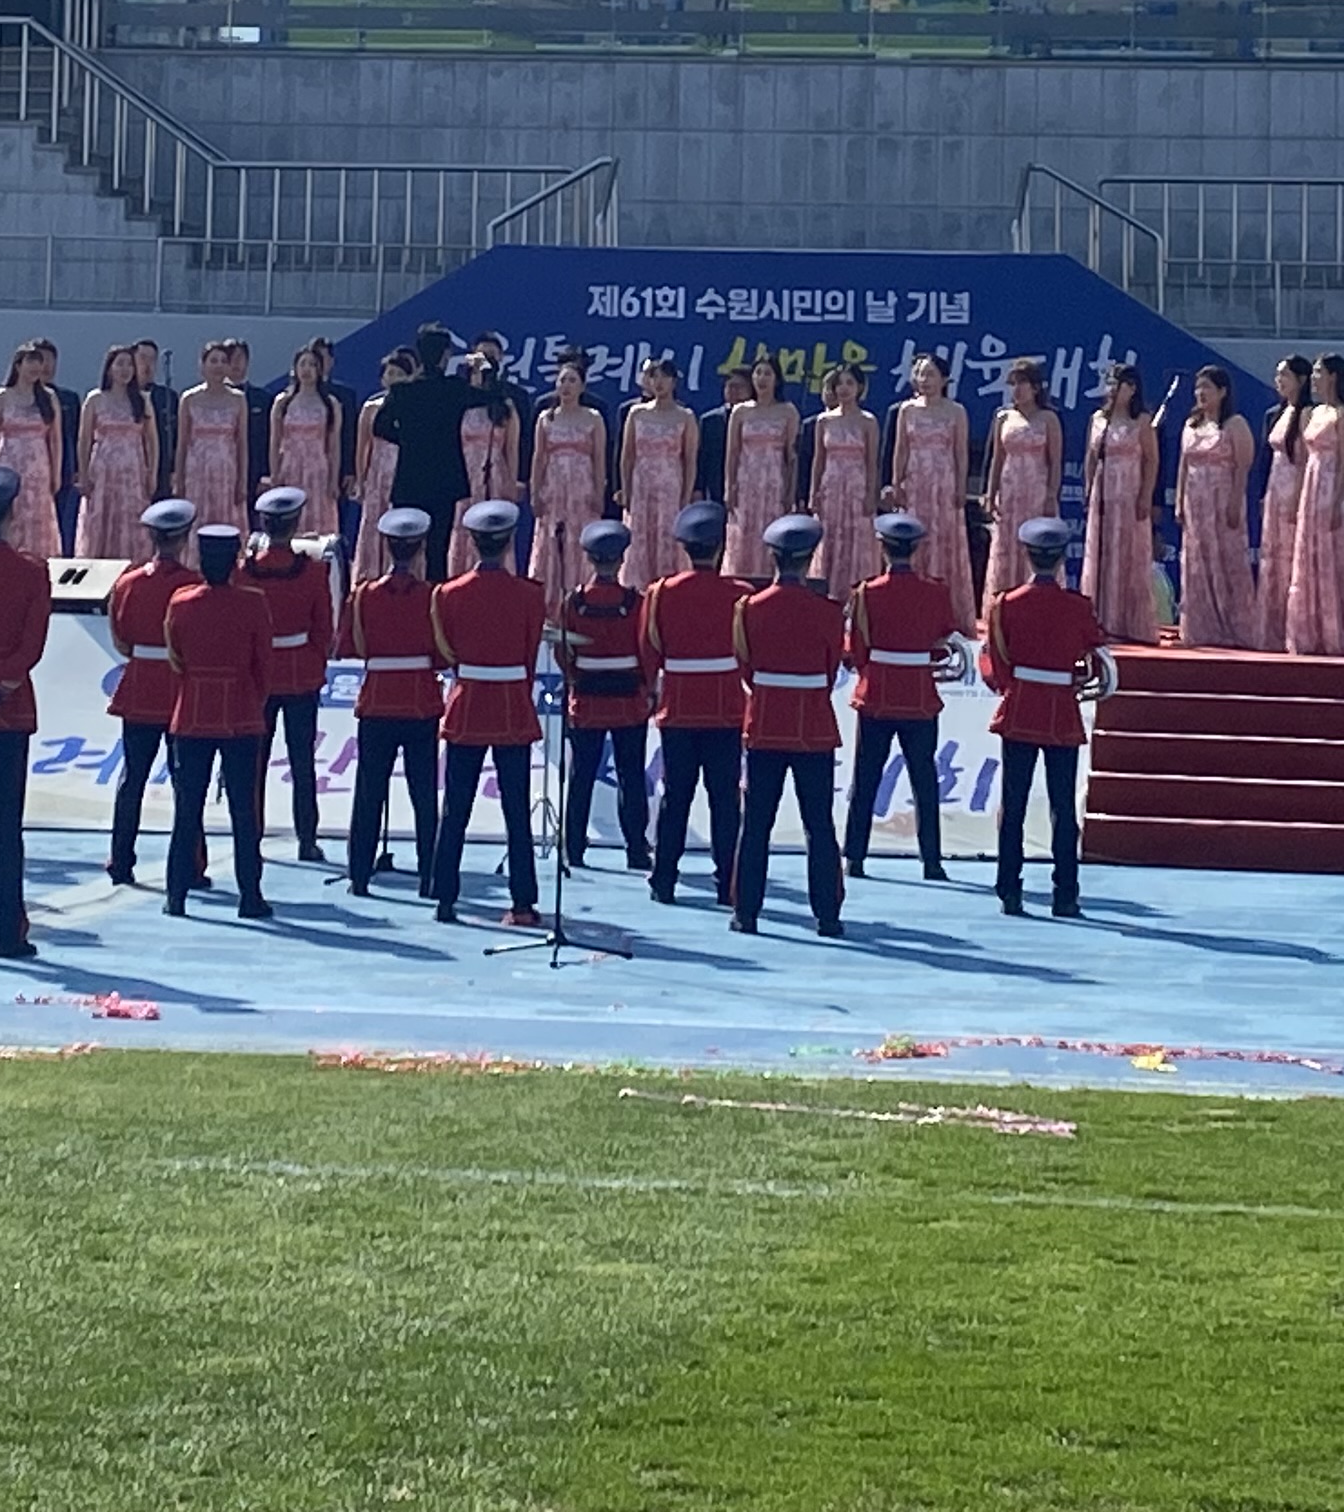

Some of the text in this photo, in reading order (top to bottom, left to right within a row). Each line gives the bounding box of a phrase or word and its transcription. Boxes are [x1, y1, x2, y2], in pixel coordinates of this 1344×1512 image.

[587, 285, 972, 325] 제61회 수원시민의 날 기념
